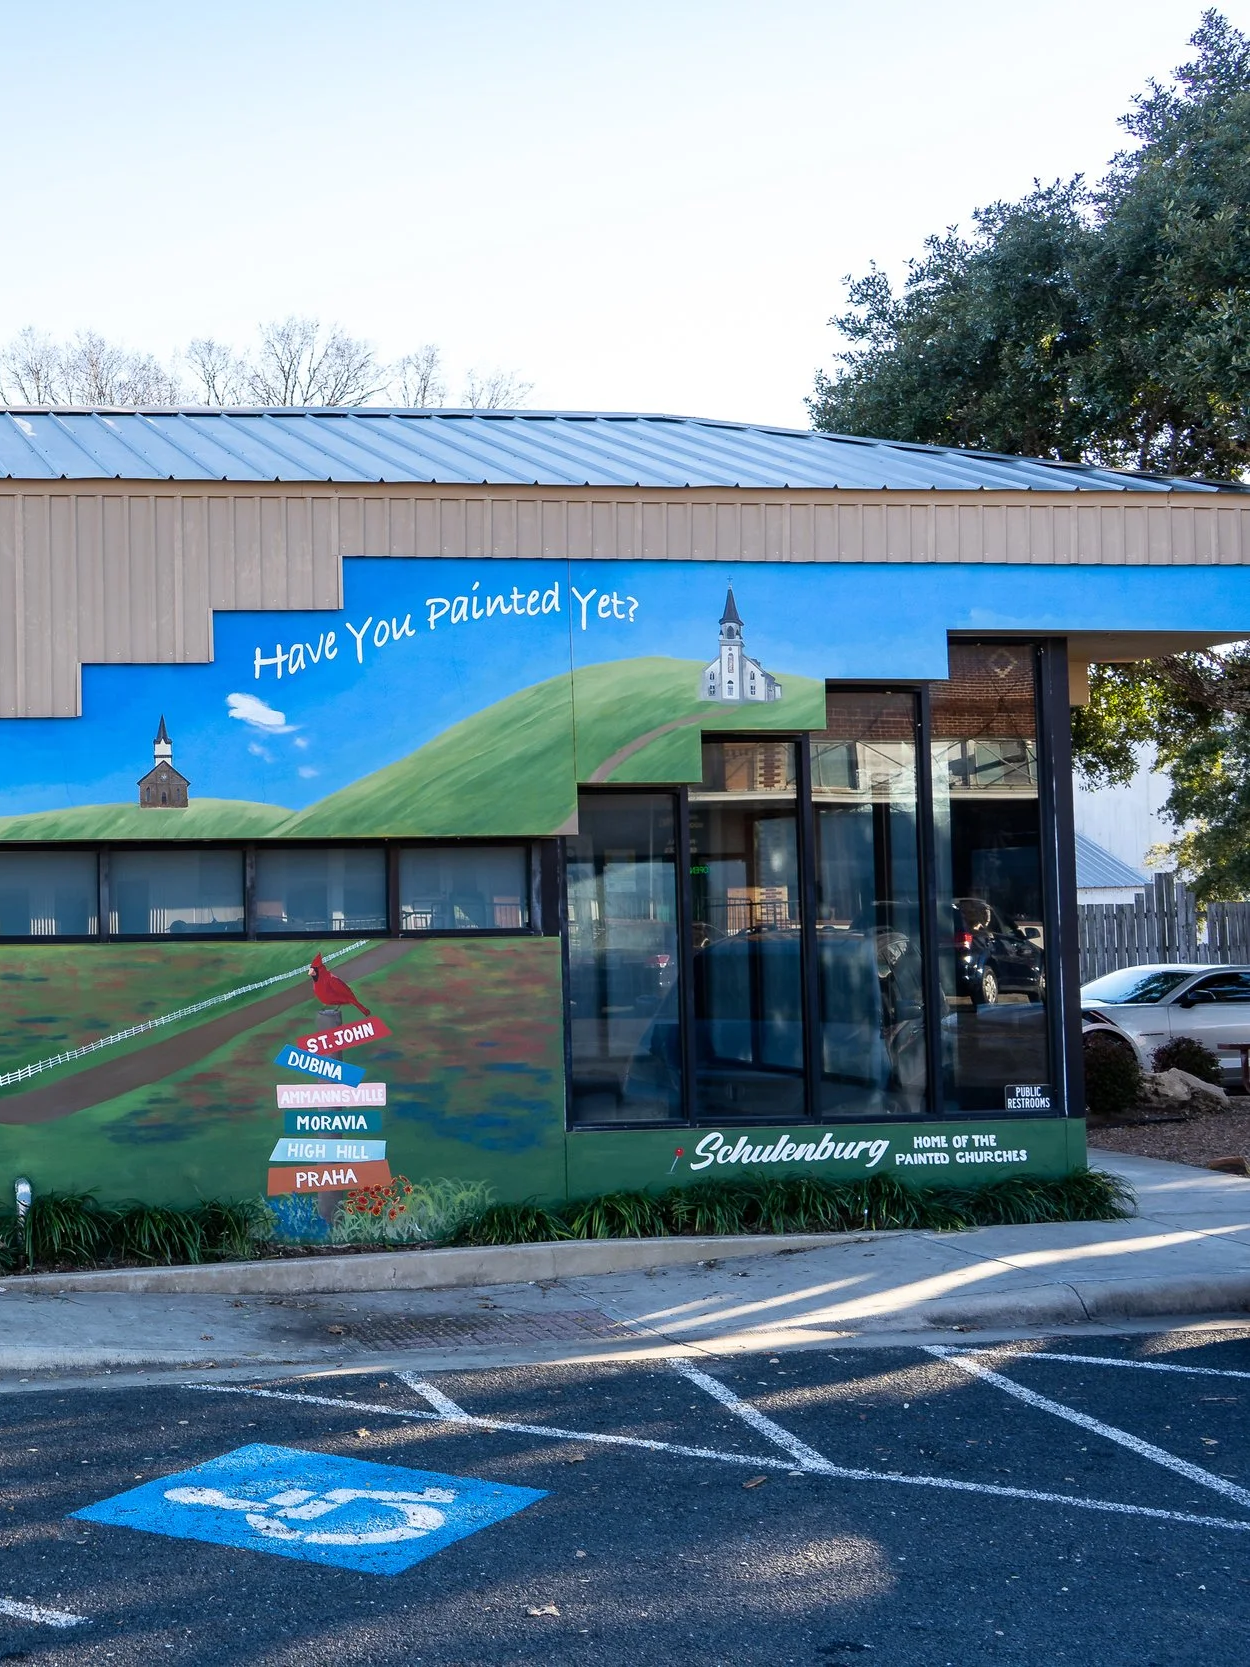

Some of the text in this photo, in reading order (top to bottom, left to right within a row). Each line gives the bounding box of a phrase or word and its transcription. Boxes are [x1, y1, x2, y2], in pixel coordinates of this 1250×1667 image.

[253, 581, 639, 680] Have You Painted Yet?
[333, 1022, 375, 1046] JOHN
[287, 1051, 343, 1081] DUBINA
[280, 1088, 384, 1105] AMMANNSVILLE
[1015, 1086, 1042, 1098] PUBLIC
[1007, 1097, 1051, 1109] RESTROOMS
[296, 1115, 368, 1131] MORAVIA
[913, 1134, 997, 1149] HOME OF THE
[287, 1143, 369, 1160] HIGH HILL
[690, 1131, 890, 1171] Schulenburg
[895, 1149, 1028, 1166] PAINTED CHURCHES
[296, 1168, 358, 1189] PRAHA
